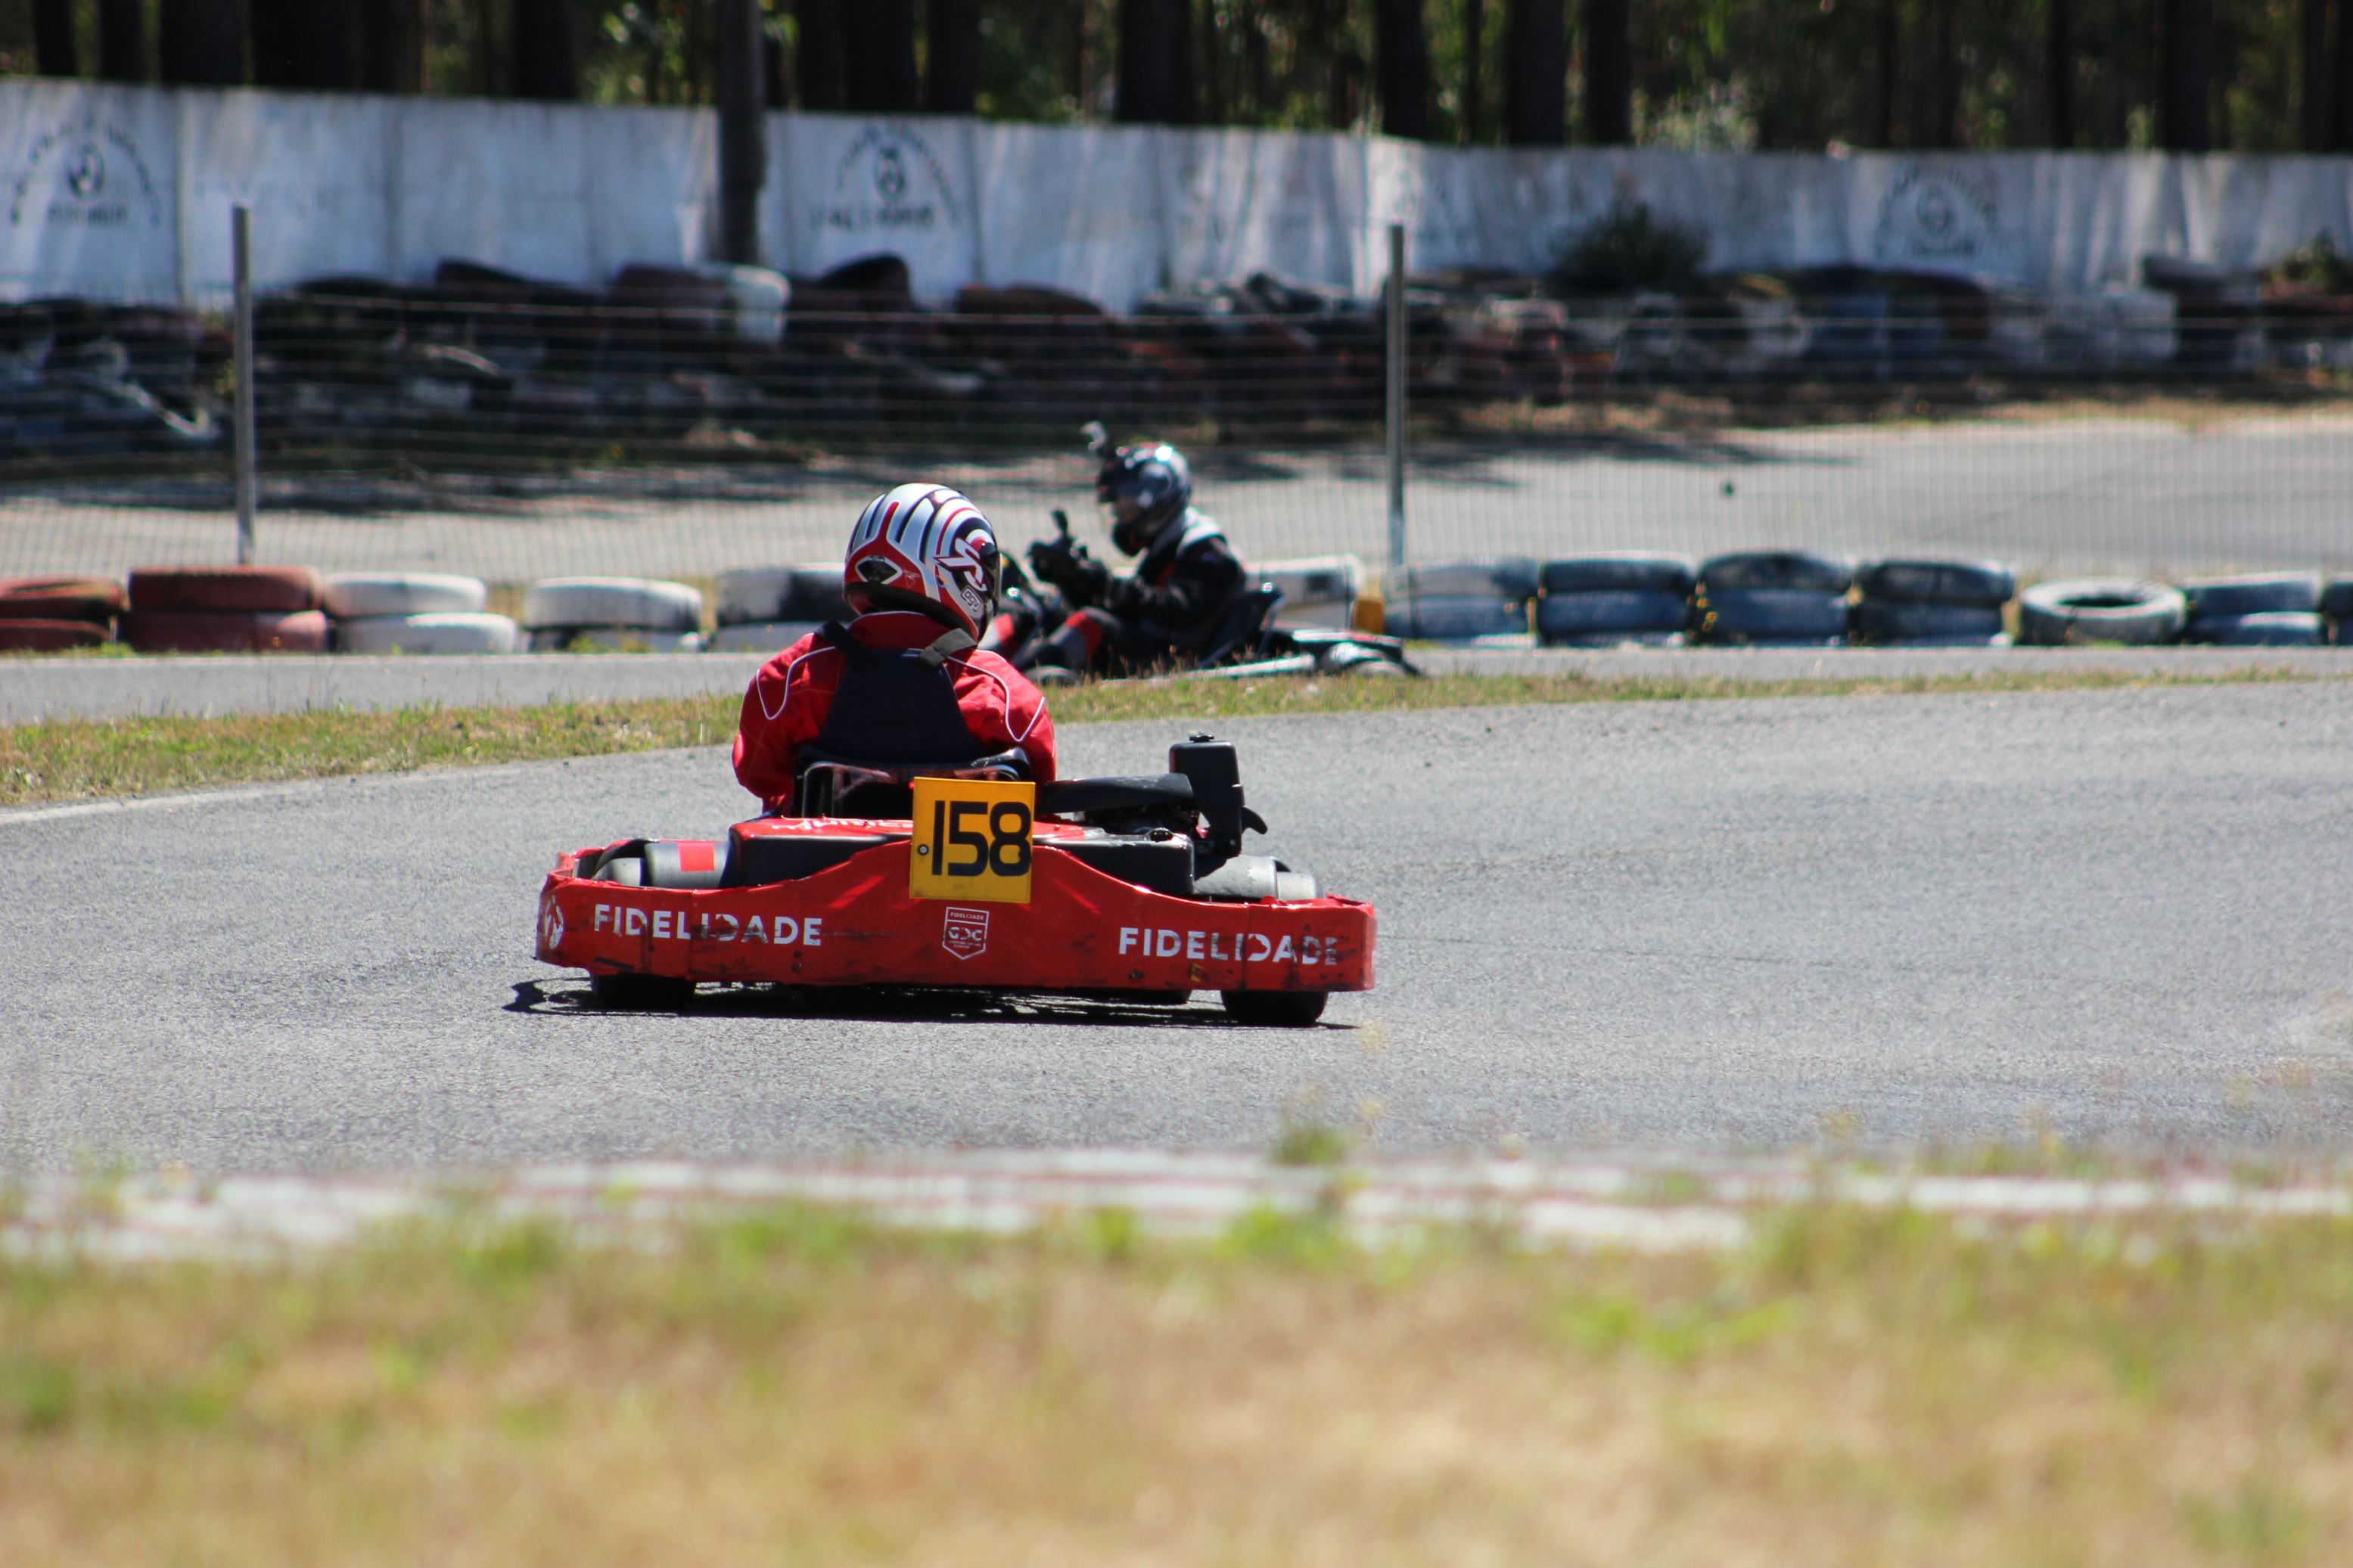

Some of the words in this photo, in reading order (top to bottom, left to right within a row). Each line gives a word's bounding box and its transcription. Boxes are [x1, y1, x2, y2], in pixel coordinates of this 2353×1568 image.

[931, 800, 1032, 877] 158
[594, 903, 823, 946] FIDELIDADE
[950, 911, 984, 921] FIDELIDADE
[1119, 927, 1338, 965] FIDELIDADE
